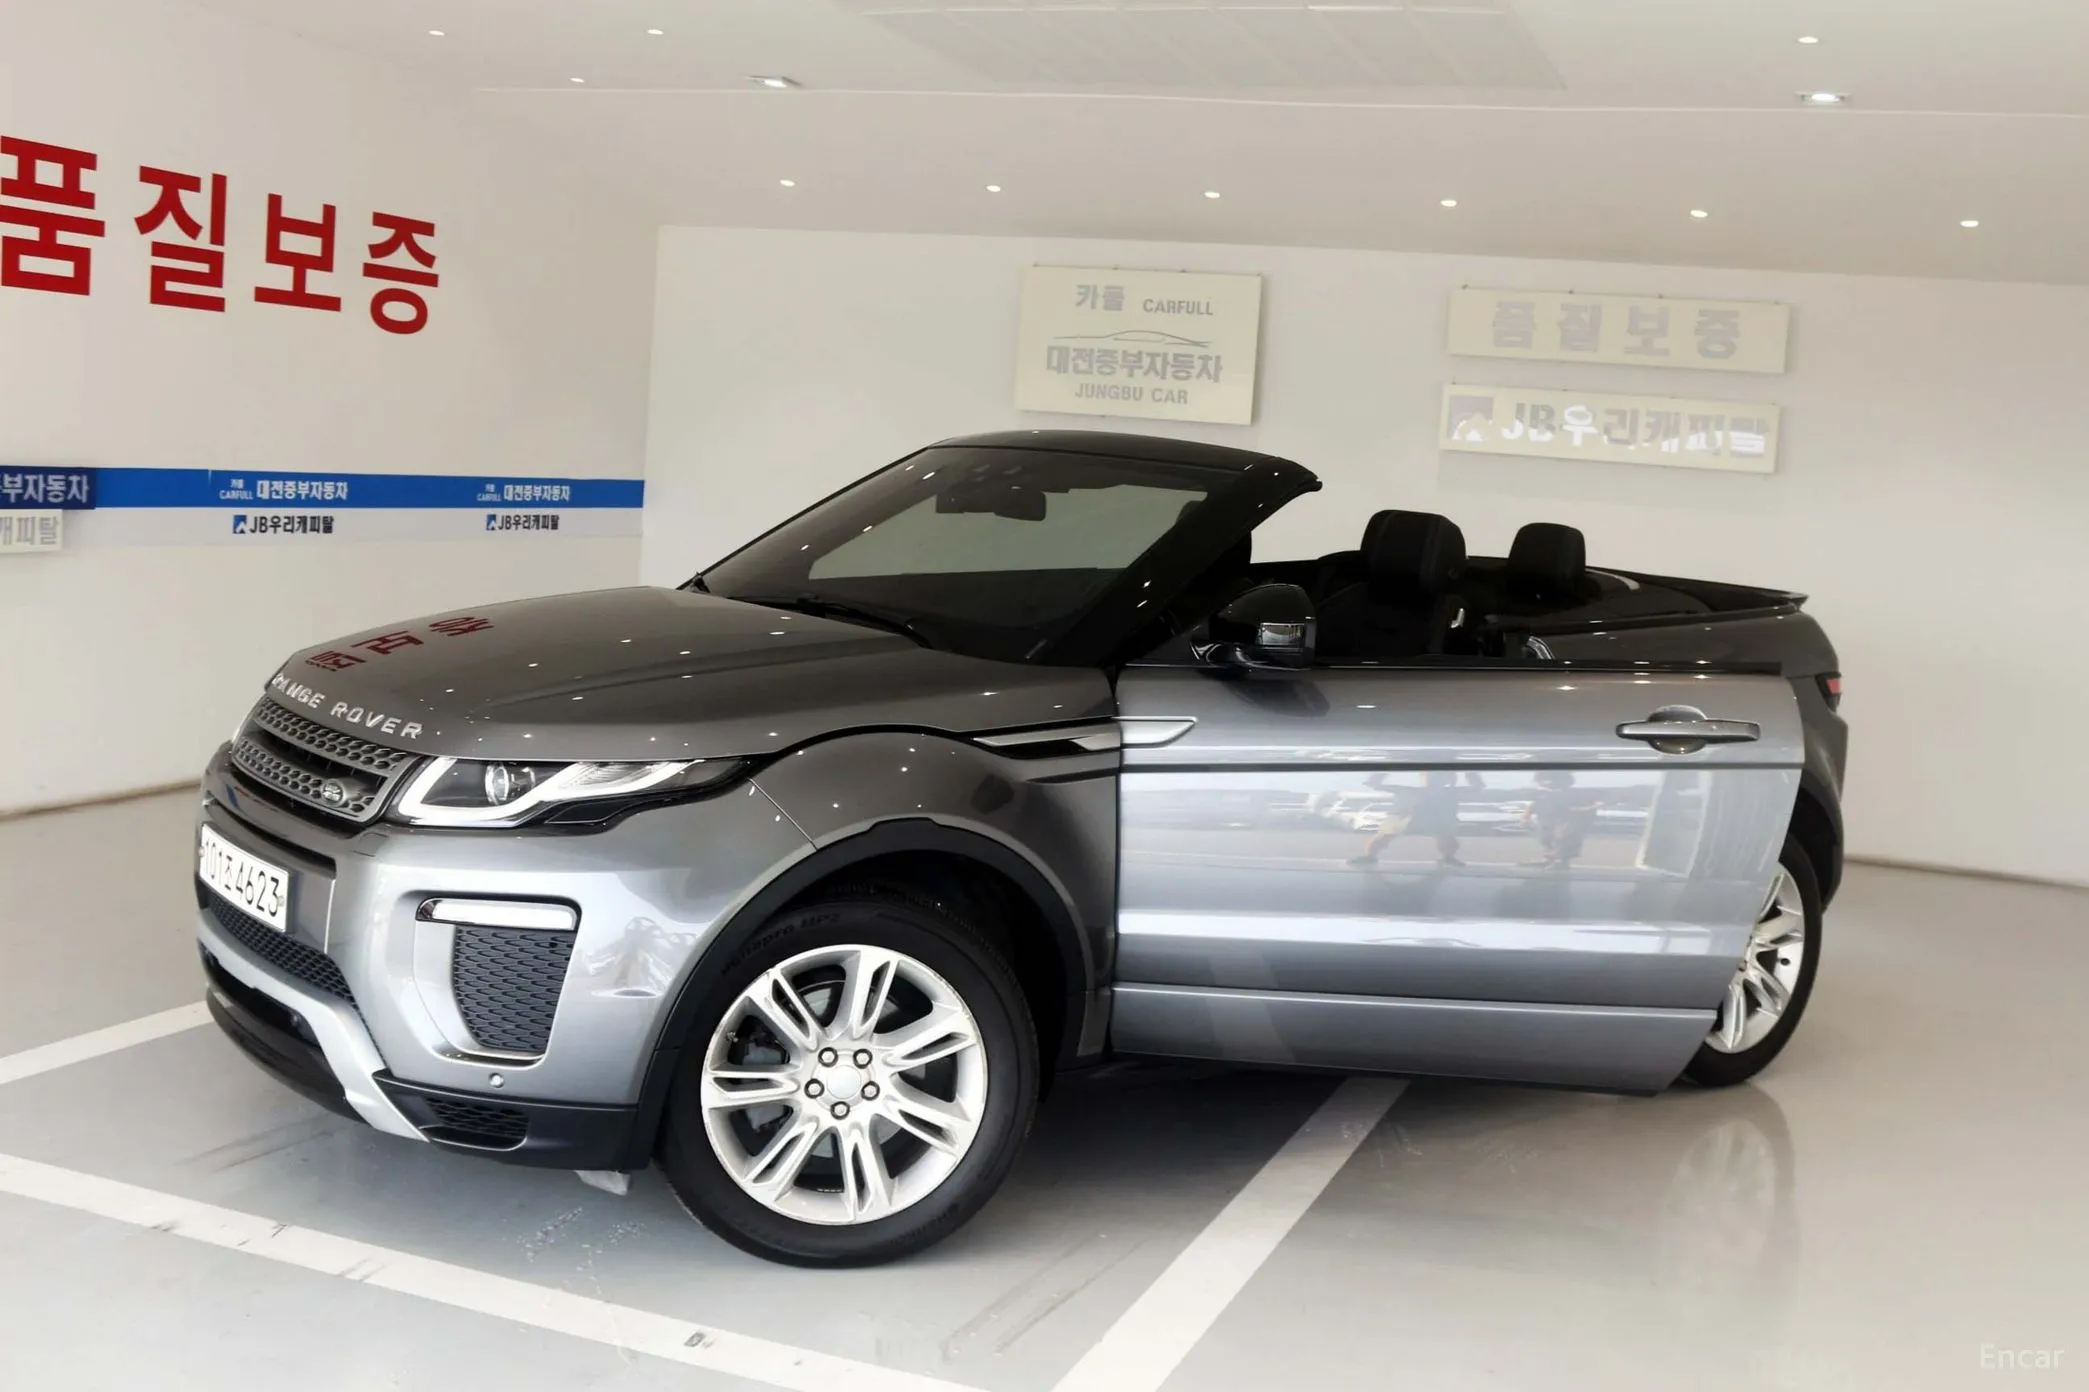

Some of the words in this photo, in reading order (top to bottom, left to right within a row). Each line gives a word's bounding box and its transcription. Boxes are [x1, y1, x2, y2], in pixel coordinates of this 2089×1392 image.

[0, 136, 439, 334] 품질보증
[1142, 298, 1214, 316] CARFULL
[1492, 300, 1741, 360] 품질보증
[1046, 345, 1223, 383] 대전중부자동차
[1075, 383, 1144, 402] JUNGBU
[1151, 387, 1189, 404] CAR
[0, 473, 90, 503] 부자동차
[271, 672, 326, 709] RANGE
[330, 701, 423, 739] ROVER
